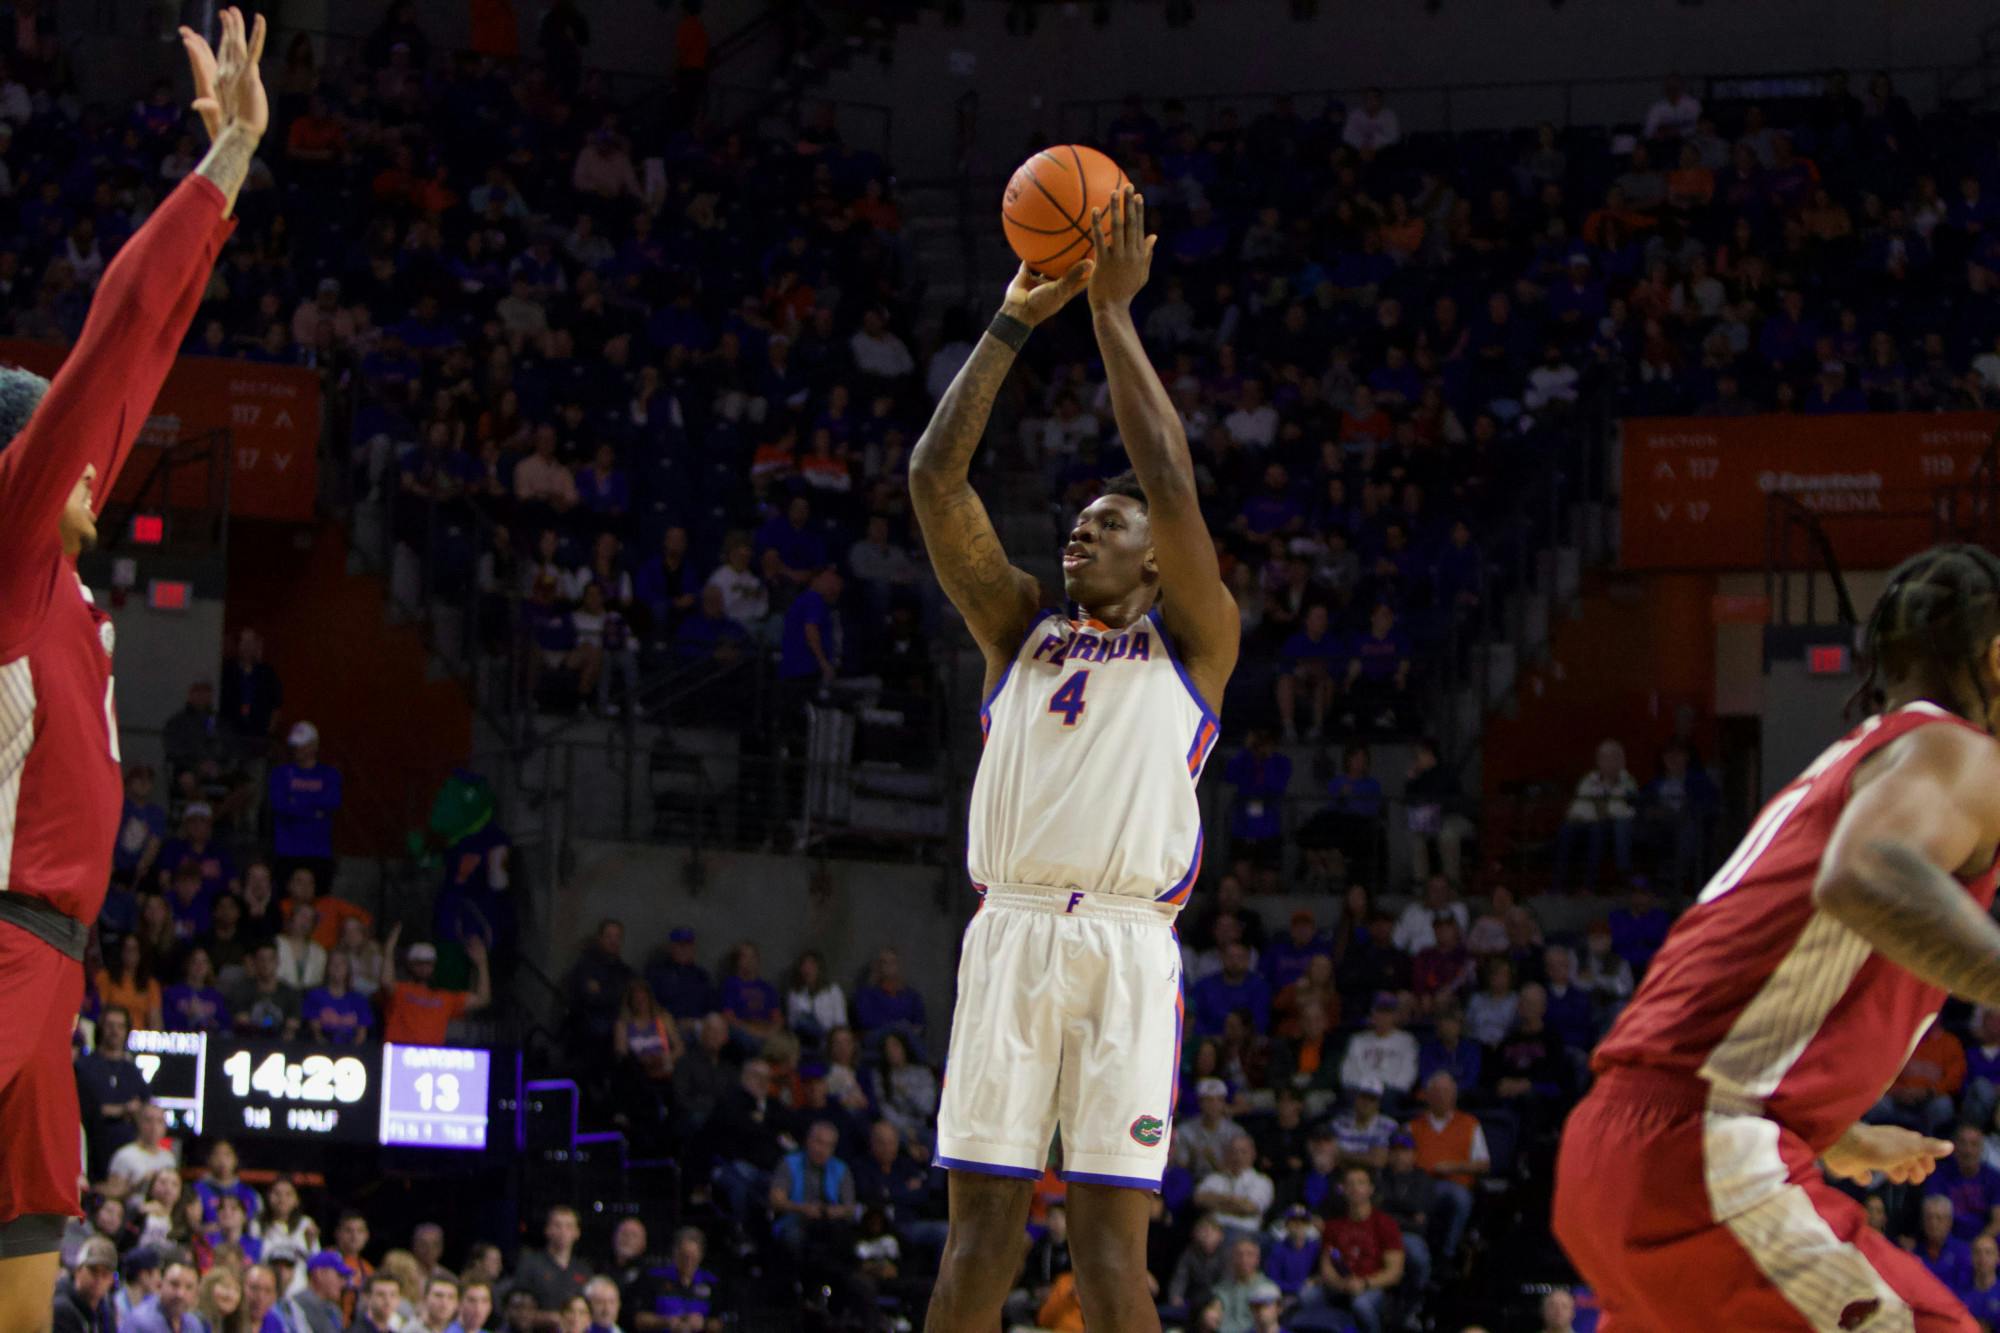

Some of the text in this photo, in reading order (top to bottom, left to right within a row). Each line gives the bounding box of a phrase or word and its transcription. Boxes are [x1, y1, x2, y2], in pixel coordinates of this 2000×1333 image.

[1048, 669, 1090, 727] 4
[1065, 891, 1085, 914] F
[135, 1053, 161, 1085] 7
[223, 1050, 367, 1104] 14:29
[414, 1072, 460, 1112] 13
